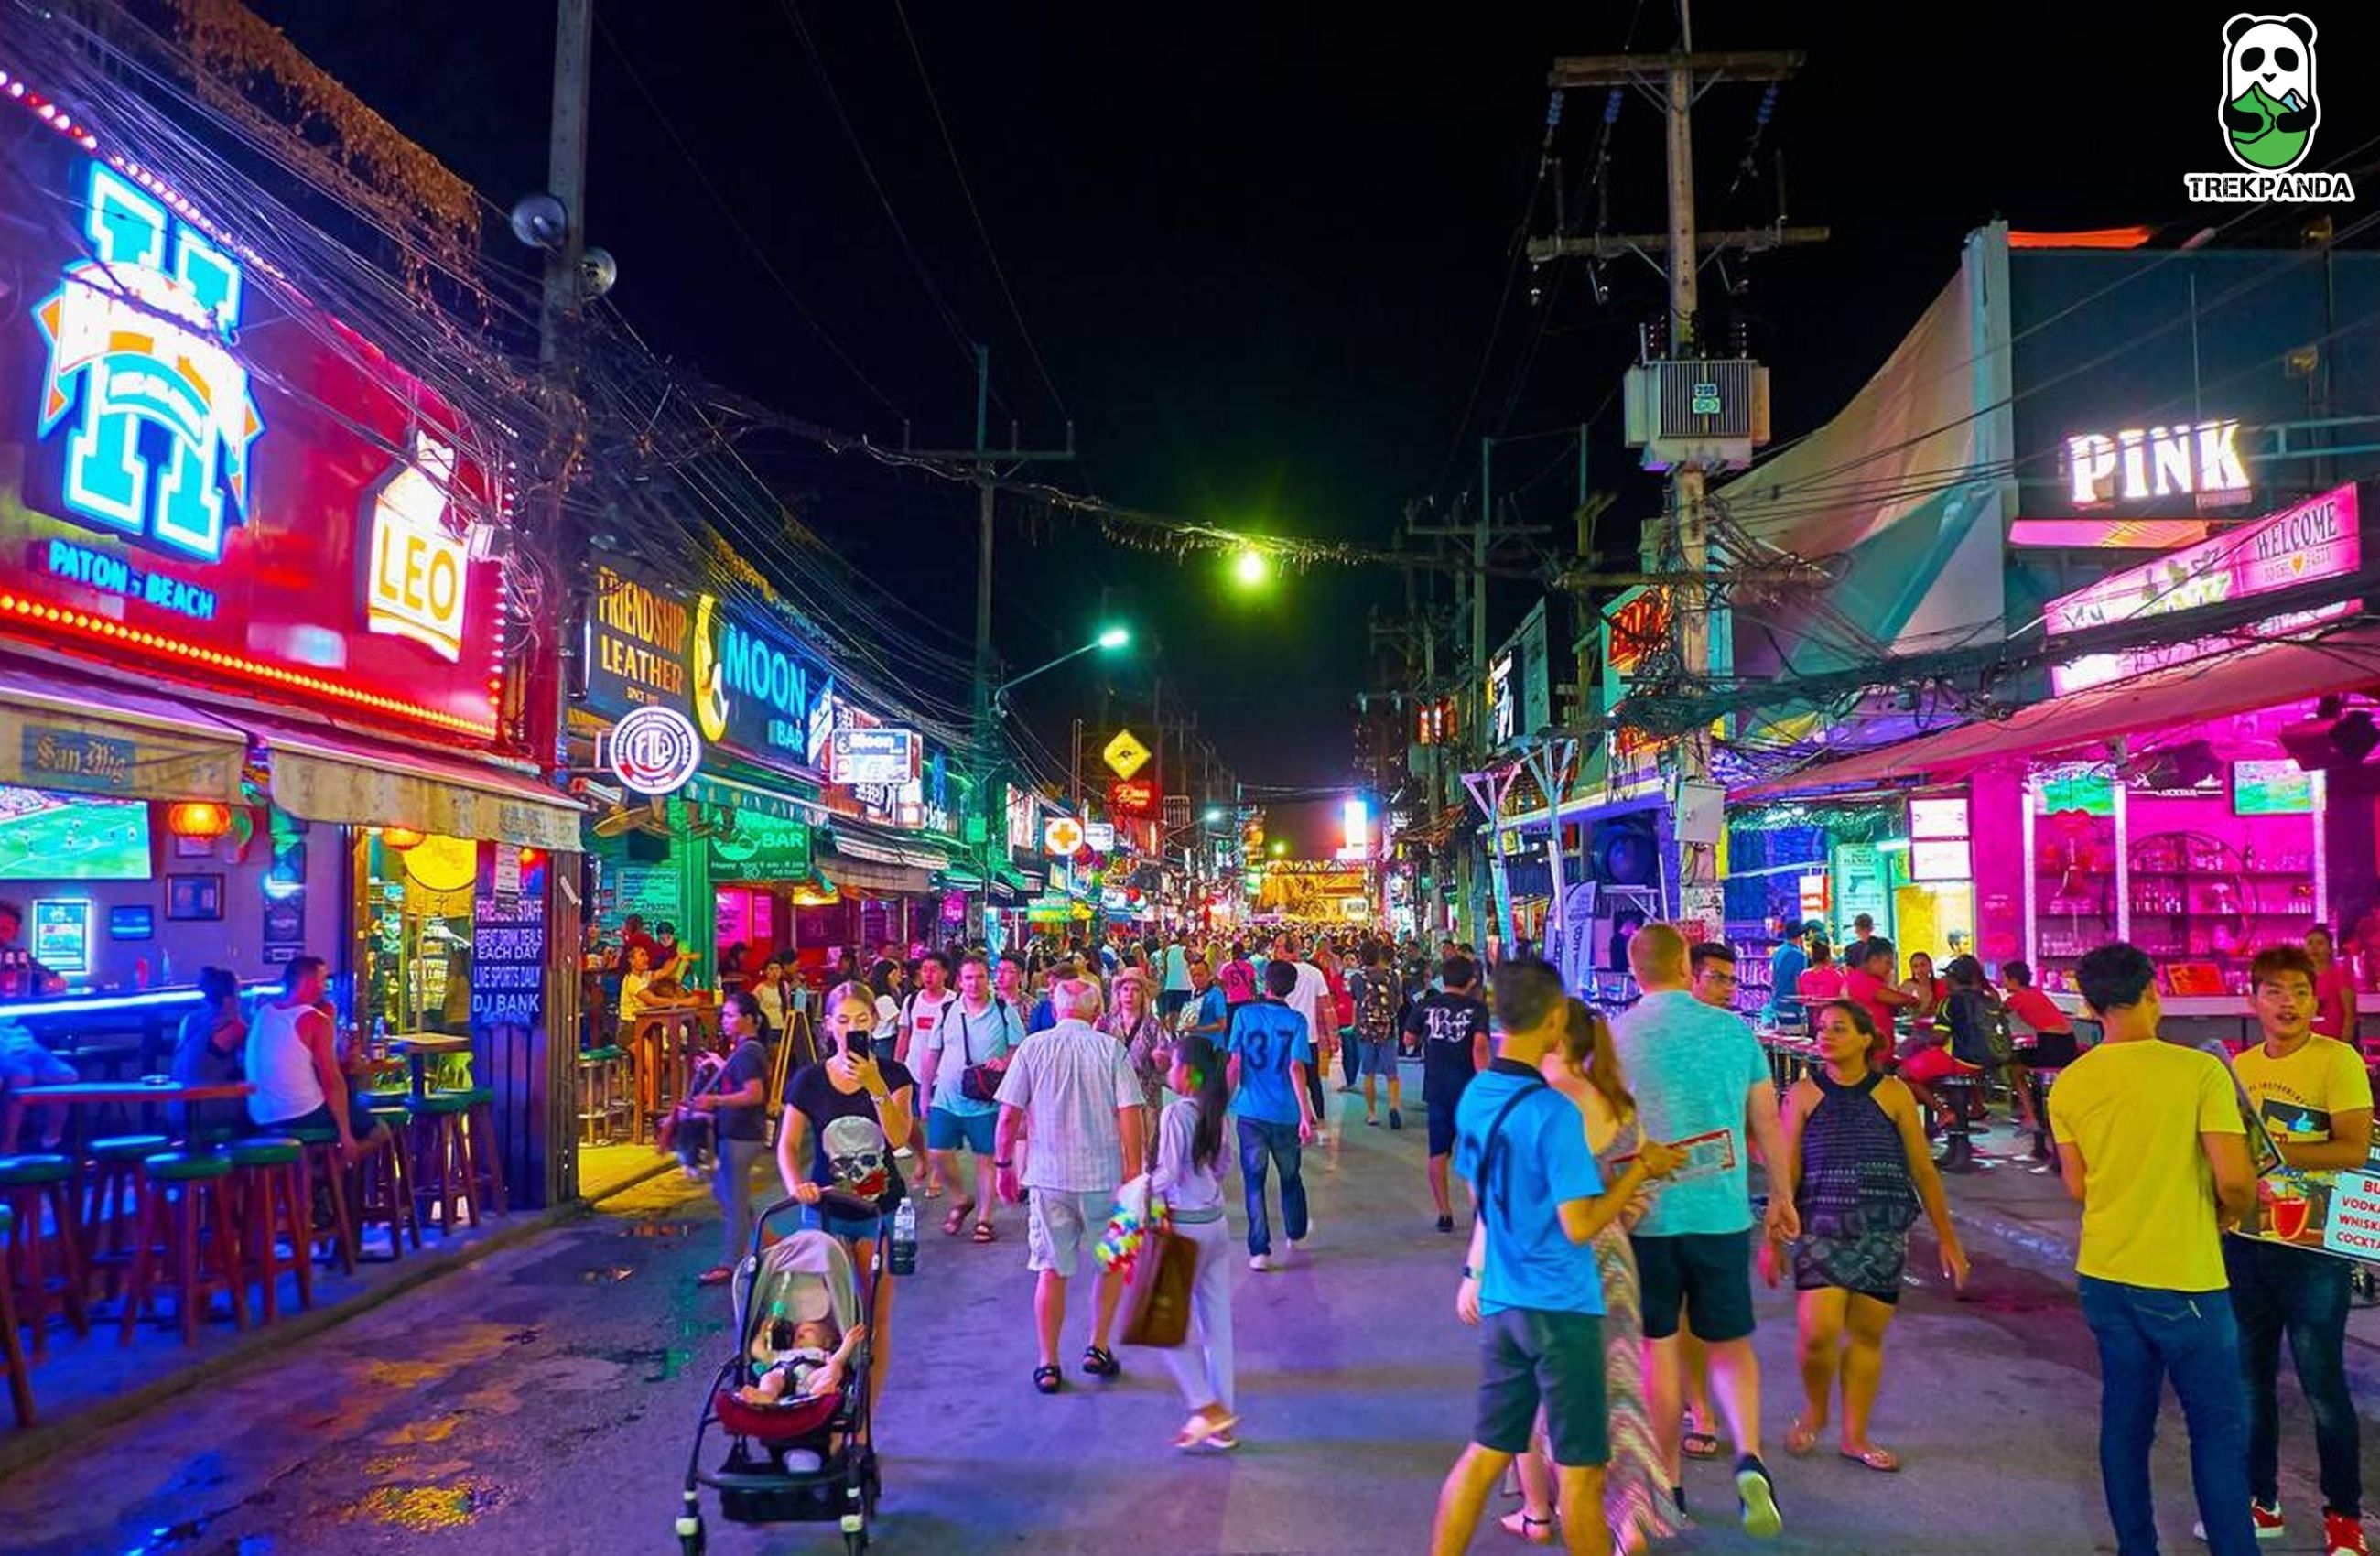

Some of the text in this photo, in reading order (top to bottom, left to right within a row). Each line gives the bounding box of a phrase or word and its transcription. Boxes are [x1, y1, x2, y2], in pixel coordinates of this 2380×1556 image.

[2068, 419, 2250, 502] PINK
[2256, 502, 2337, 560] WELCOME
[145, 573, 215, 620] BEACH
[379, 524, 457, 621] LEO
[599, 565, 687, 655] FRIENDSHIP
[601, 633, 683, 696] LEATHER
[725, 622, 806, 720] MOON
[37, 734, 127, 783] San Mig
[775, 719, 805, 756] BAR
[762, 831, 804, 848] BAR
[518, 900, 542, 922] STAFF
[478, 946, 539, 959] EACH DAY
[472, 994, 540, 1012] DJ BANK
[1247, 1029, 1293, 1074] 37
